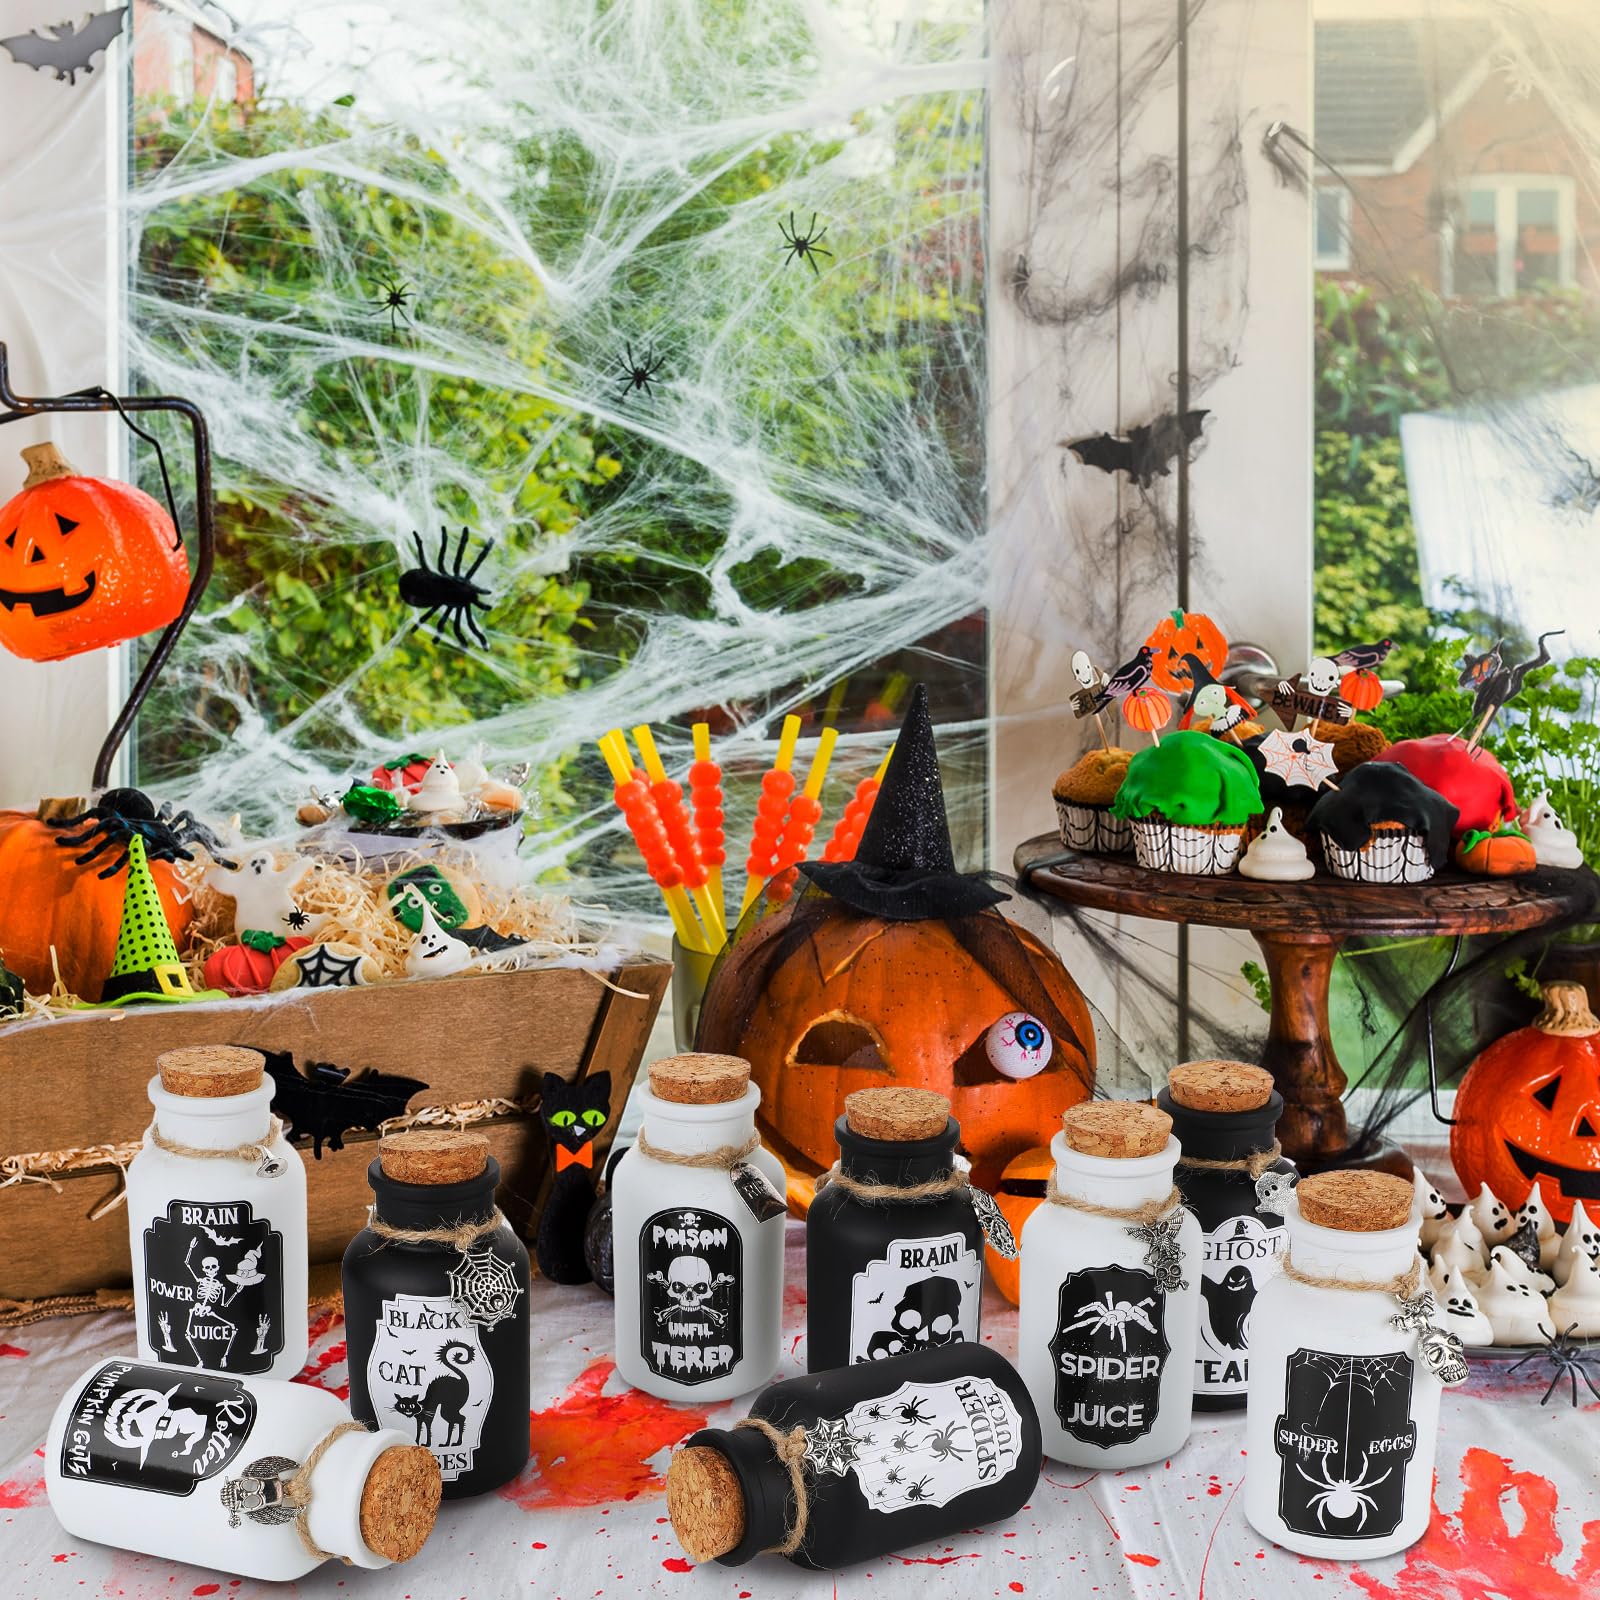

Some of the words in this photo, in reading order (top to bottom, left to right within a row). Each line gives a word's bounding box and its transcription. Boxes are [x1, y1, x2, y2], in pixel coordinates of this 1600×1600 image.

[181, 1206, 239, 1226] BRAIN
[652, 1225, 729, 1253] POISON
[1202, 1235, 1282, 1261] GHOST
[899, 1243, 959, 1269] BRAIN
[150, 1277, 195, 1302] POWER
[190, 1325, 231, 1340] JUICE
[388, 1309, 463, 1330] BLACK
[668, 1321, 714, 1342] UNFIL
[651, 1341, 734, 1375] TERED
[1059, 1352, 1160, 1381] SPIDER
[378, 1361, 426, 1386] CAT
[983, 1391, 1014, 1457] JUICE
[1067, 1402, 1145, 1428] JUICE
[193, 1395, 247, 1476] Rotten
[955, 1381, 997, 1481] SPIDER
[1279, 1429, 1339, 1456] SPIDER
[1368, 1433, 1413, 1455] EGGS
